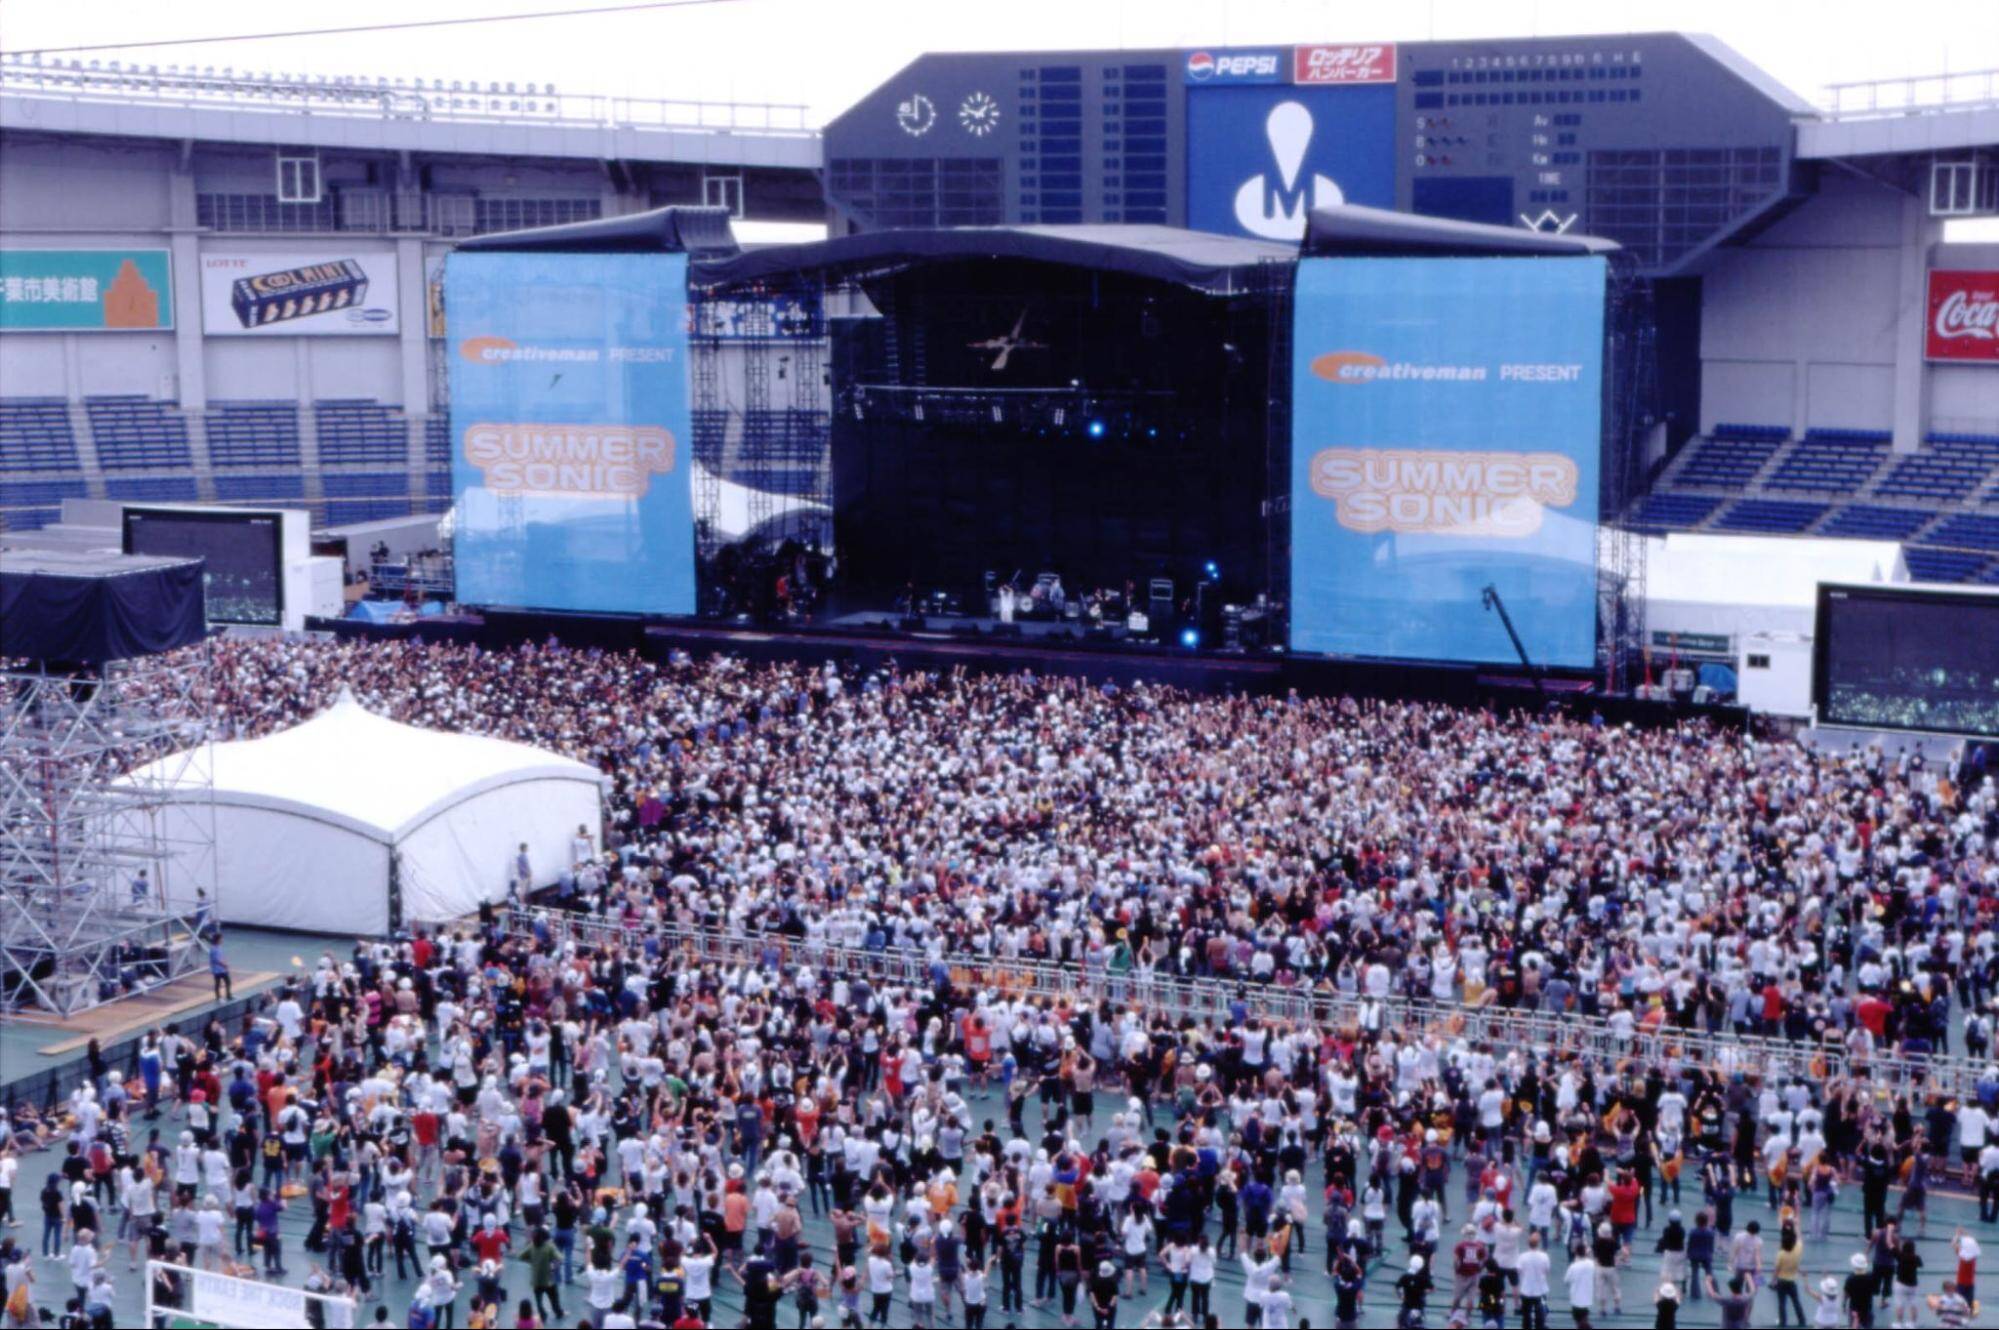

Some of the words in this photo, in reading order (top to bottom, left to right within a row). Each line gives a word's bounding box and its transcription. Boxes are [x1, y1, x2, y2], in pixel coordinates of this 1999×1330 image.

[1216, 56, 1278, 75] PEPSI
[1307, 47, 1383, 67] ロッテリア
[1465, 57, 1474, 69] 2
[1479, 56, 1488, 69] 3
[1492, 56, 1501, 68] 4
[1520, 54, 1530, 67] 6
[1535, 54, 1545, 66] 7
[1547, 54, 1558, 66] 8
[1307, 66, 1383, 80] ハンバーガー
[0, 276, 98, 302] 葉市美術館
[482, 345, 599, 363] creativeman
[608, 347, 675, 363] PRESENT
[1338, 362, 1487, 381] creativeman
[1500, 364, 1583, 382] PRESENT
[471, 431, 666, 463] SUMMER
[491, 462, 641, 492] SONIC
[1321, 458, 1568, 494] SUMMER
[1347, 492, 1523, 526] SONIC
